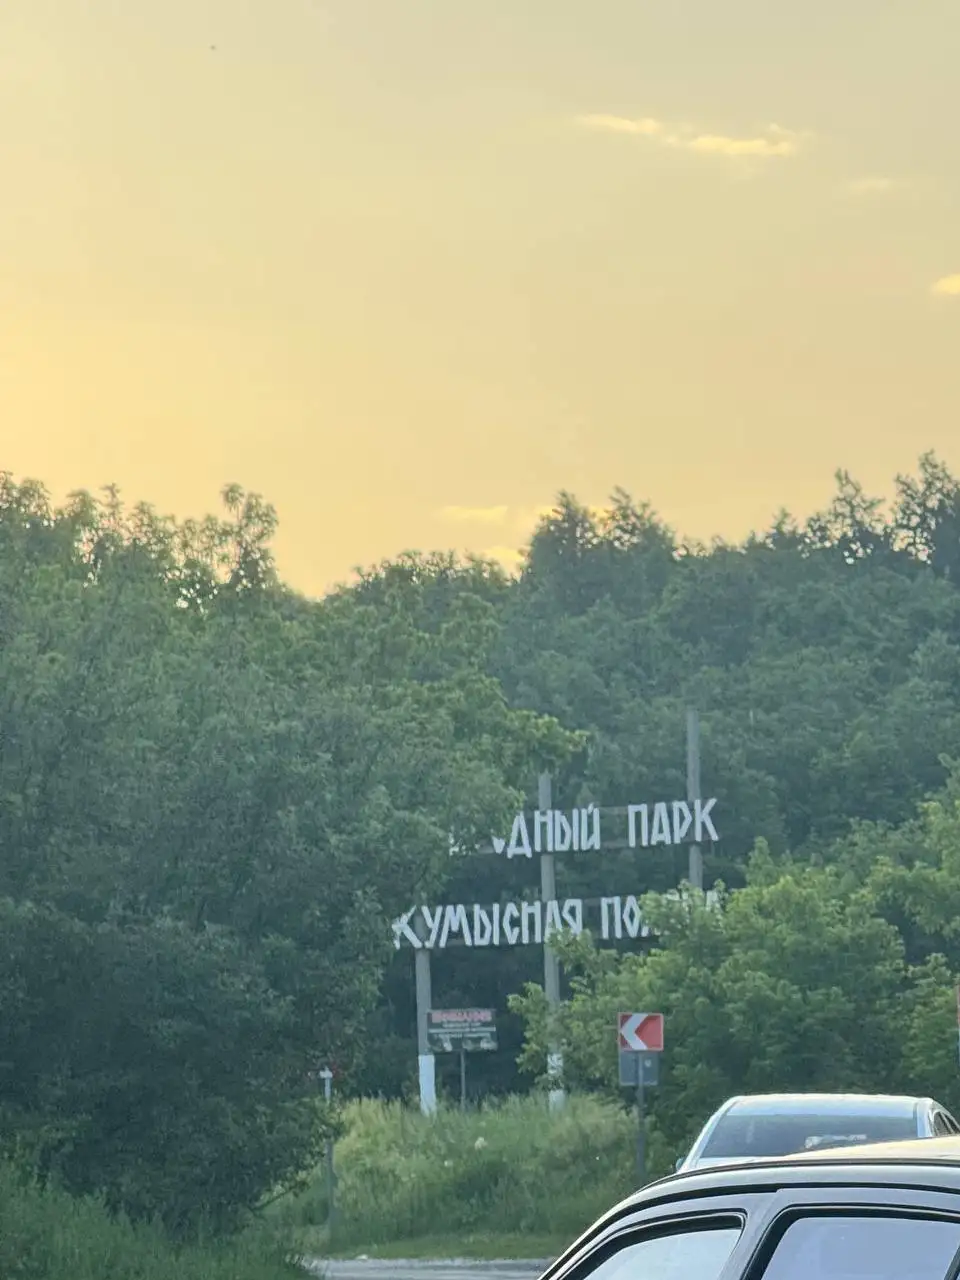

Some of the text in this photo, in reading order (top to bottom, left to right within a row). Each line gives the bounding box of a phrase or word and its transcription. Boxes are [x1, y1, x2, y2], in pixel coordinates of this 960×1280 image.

[491, 798, 719, 858] ДНЫЙ ПАРК
[391, 898, 583, 950] КУМЫСНАЯ
